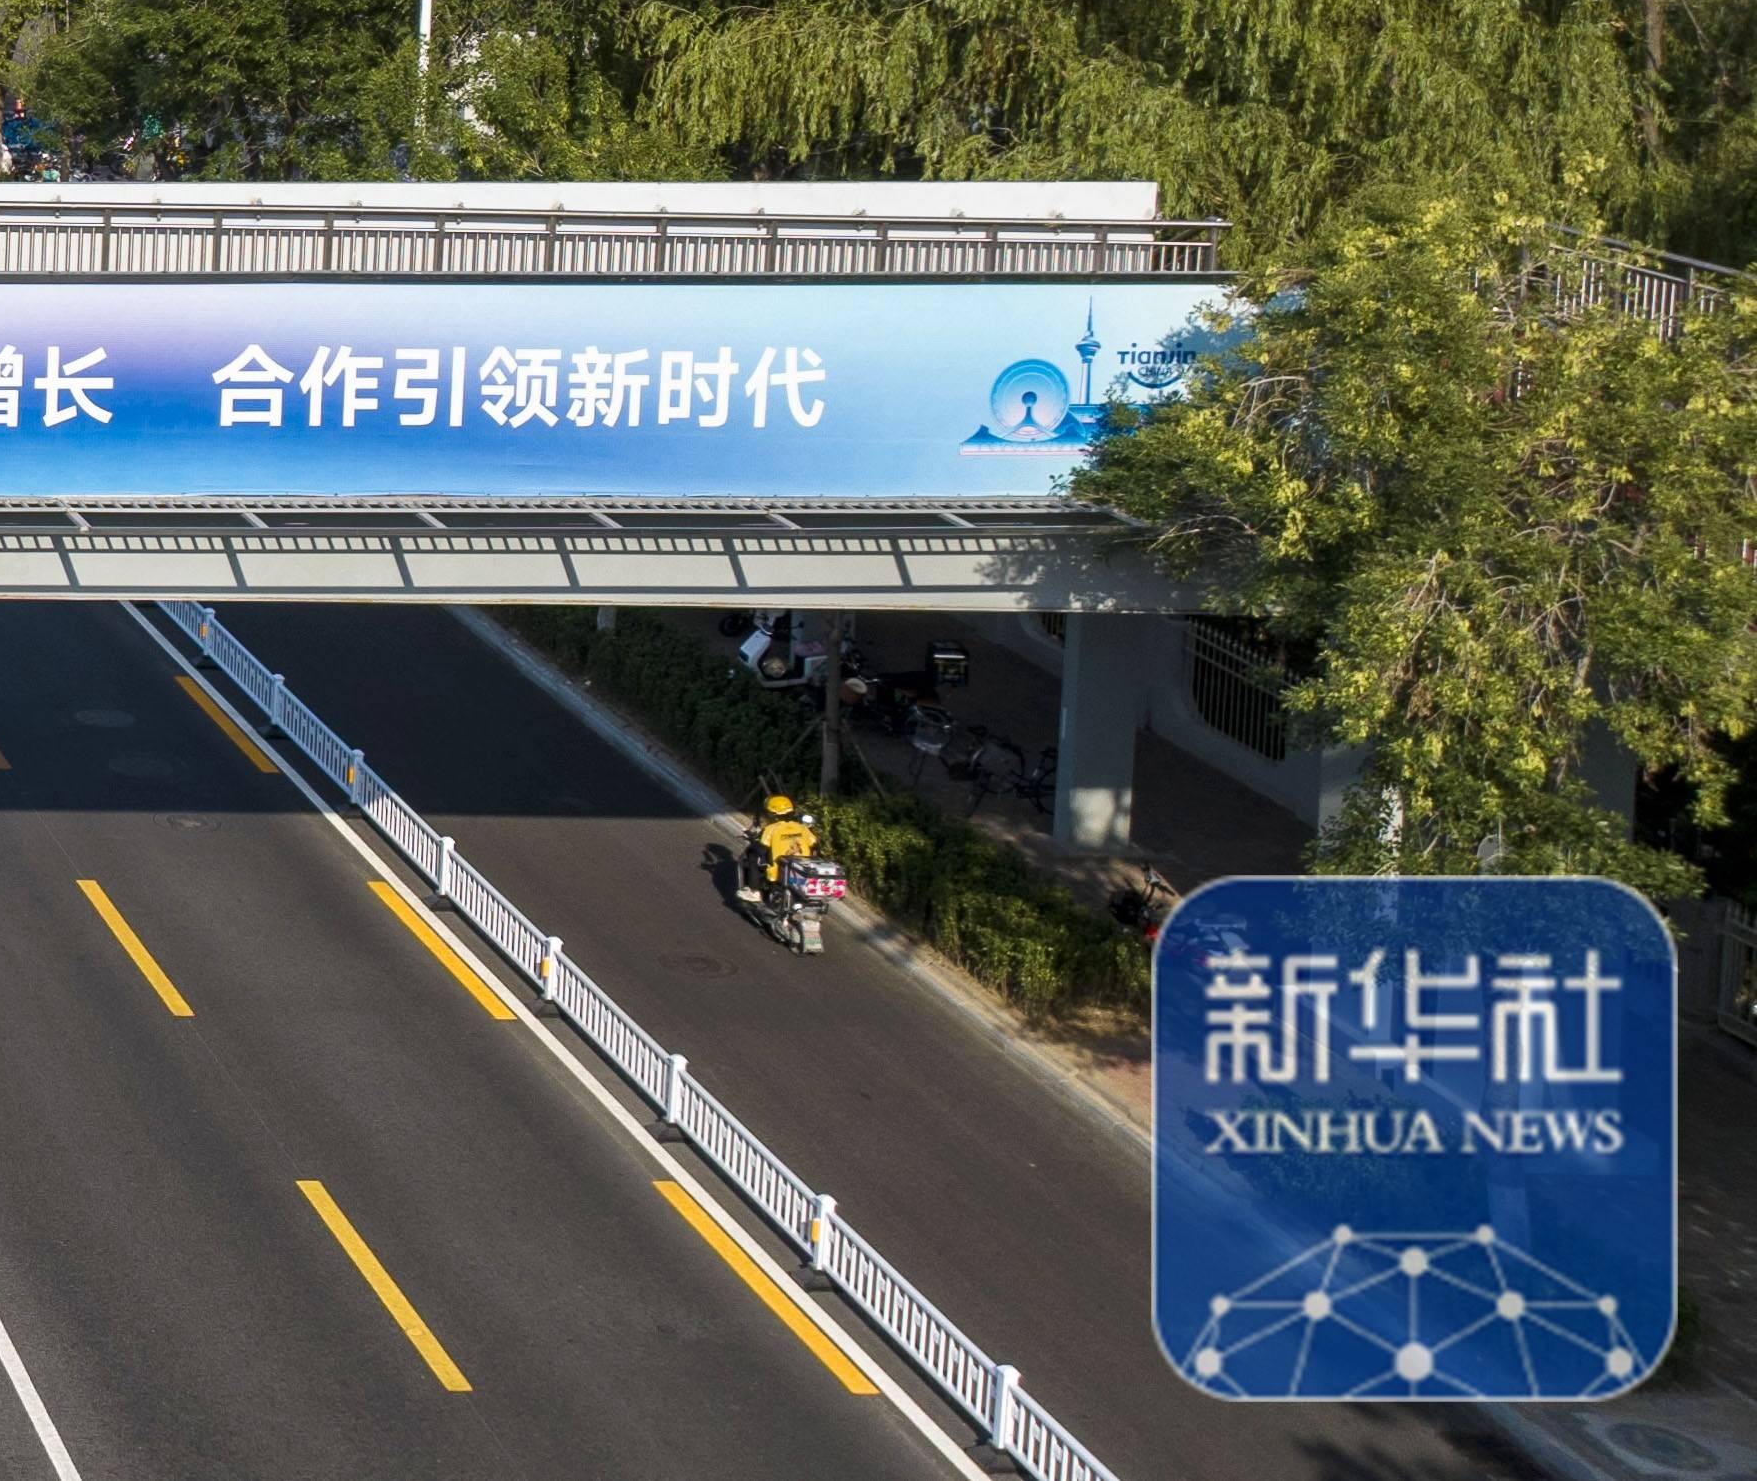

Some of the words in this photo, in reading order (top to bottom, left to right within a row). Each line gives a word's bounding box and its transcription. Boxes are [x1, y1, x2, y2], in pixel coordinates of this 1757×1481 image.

[211, 344, 827, 428] 合作引领新时代
